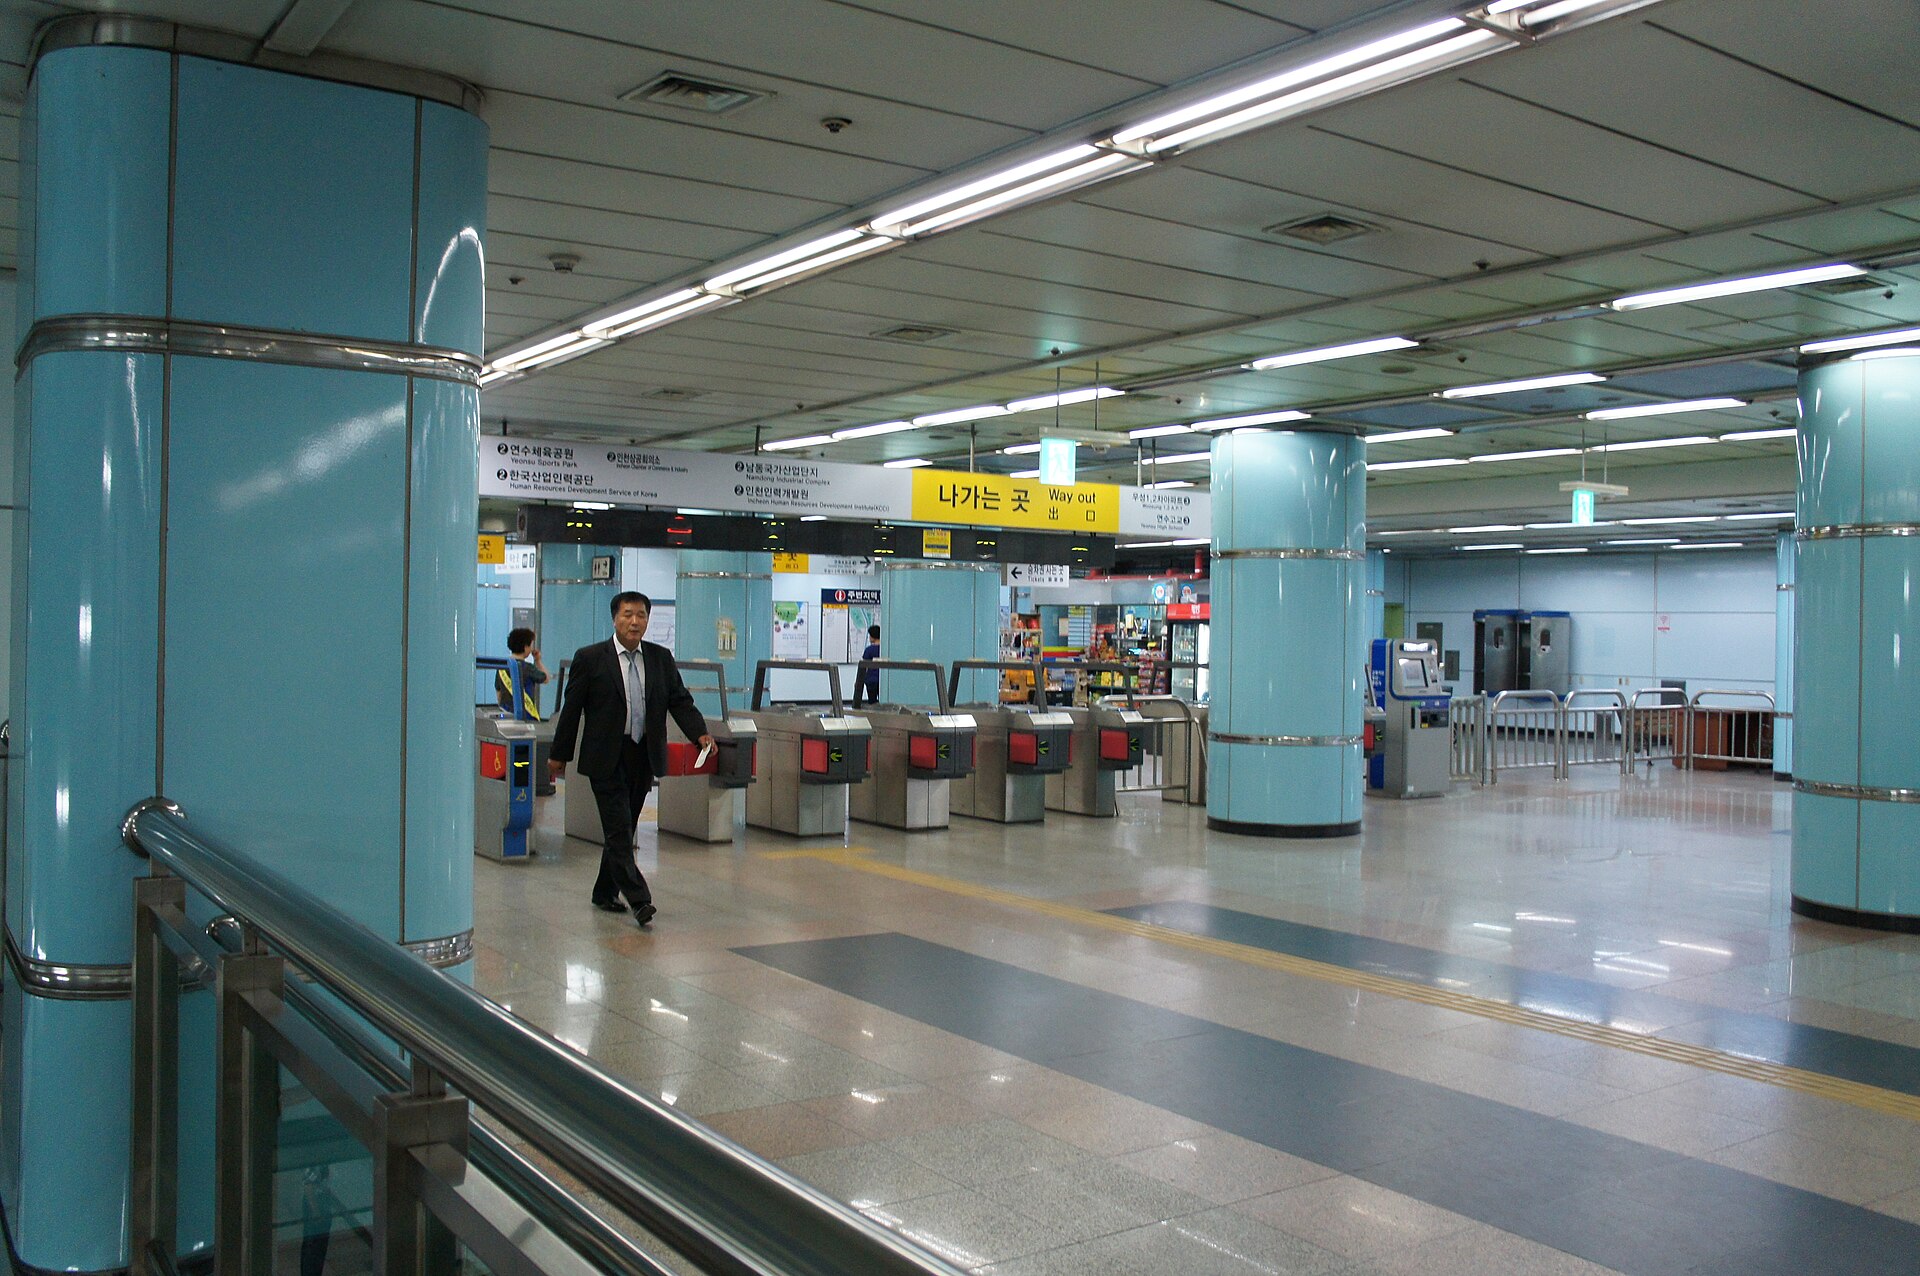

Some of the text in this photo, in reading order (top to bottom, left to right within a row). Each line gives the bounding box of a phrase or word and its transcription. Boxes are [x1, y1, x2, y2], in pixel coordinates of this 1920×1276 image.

[510, 444, 574, 460] 연수체육공원
[511, 457, 578, 468] Yeonsu Sports Park
[746, 462, 818, 478] 남동국가산업단지
[510, 470, 594, 486] 한국산업인력공단
[746, 473, 775, 483] Namdong
[777, 476, 803, 484] Industrial
[533, 484, 566, 493] Resources
[568, 486, 607, 496] Development
[609, 488, 631, 497] Service
[746, 486, 809, 499] 인천인력개발원
[1048, 488, 1096, 504] Way out
[771, 498, 789, 506] Human
[790, 500, 818, 508] Resources
[939, 483, 1031, 513] 나가는 곳
